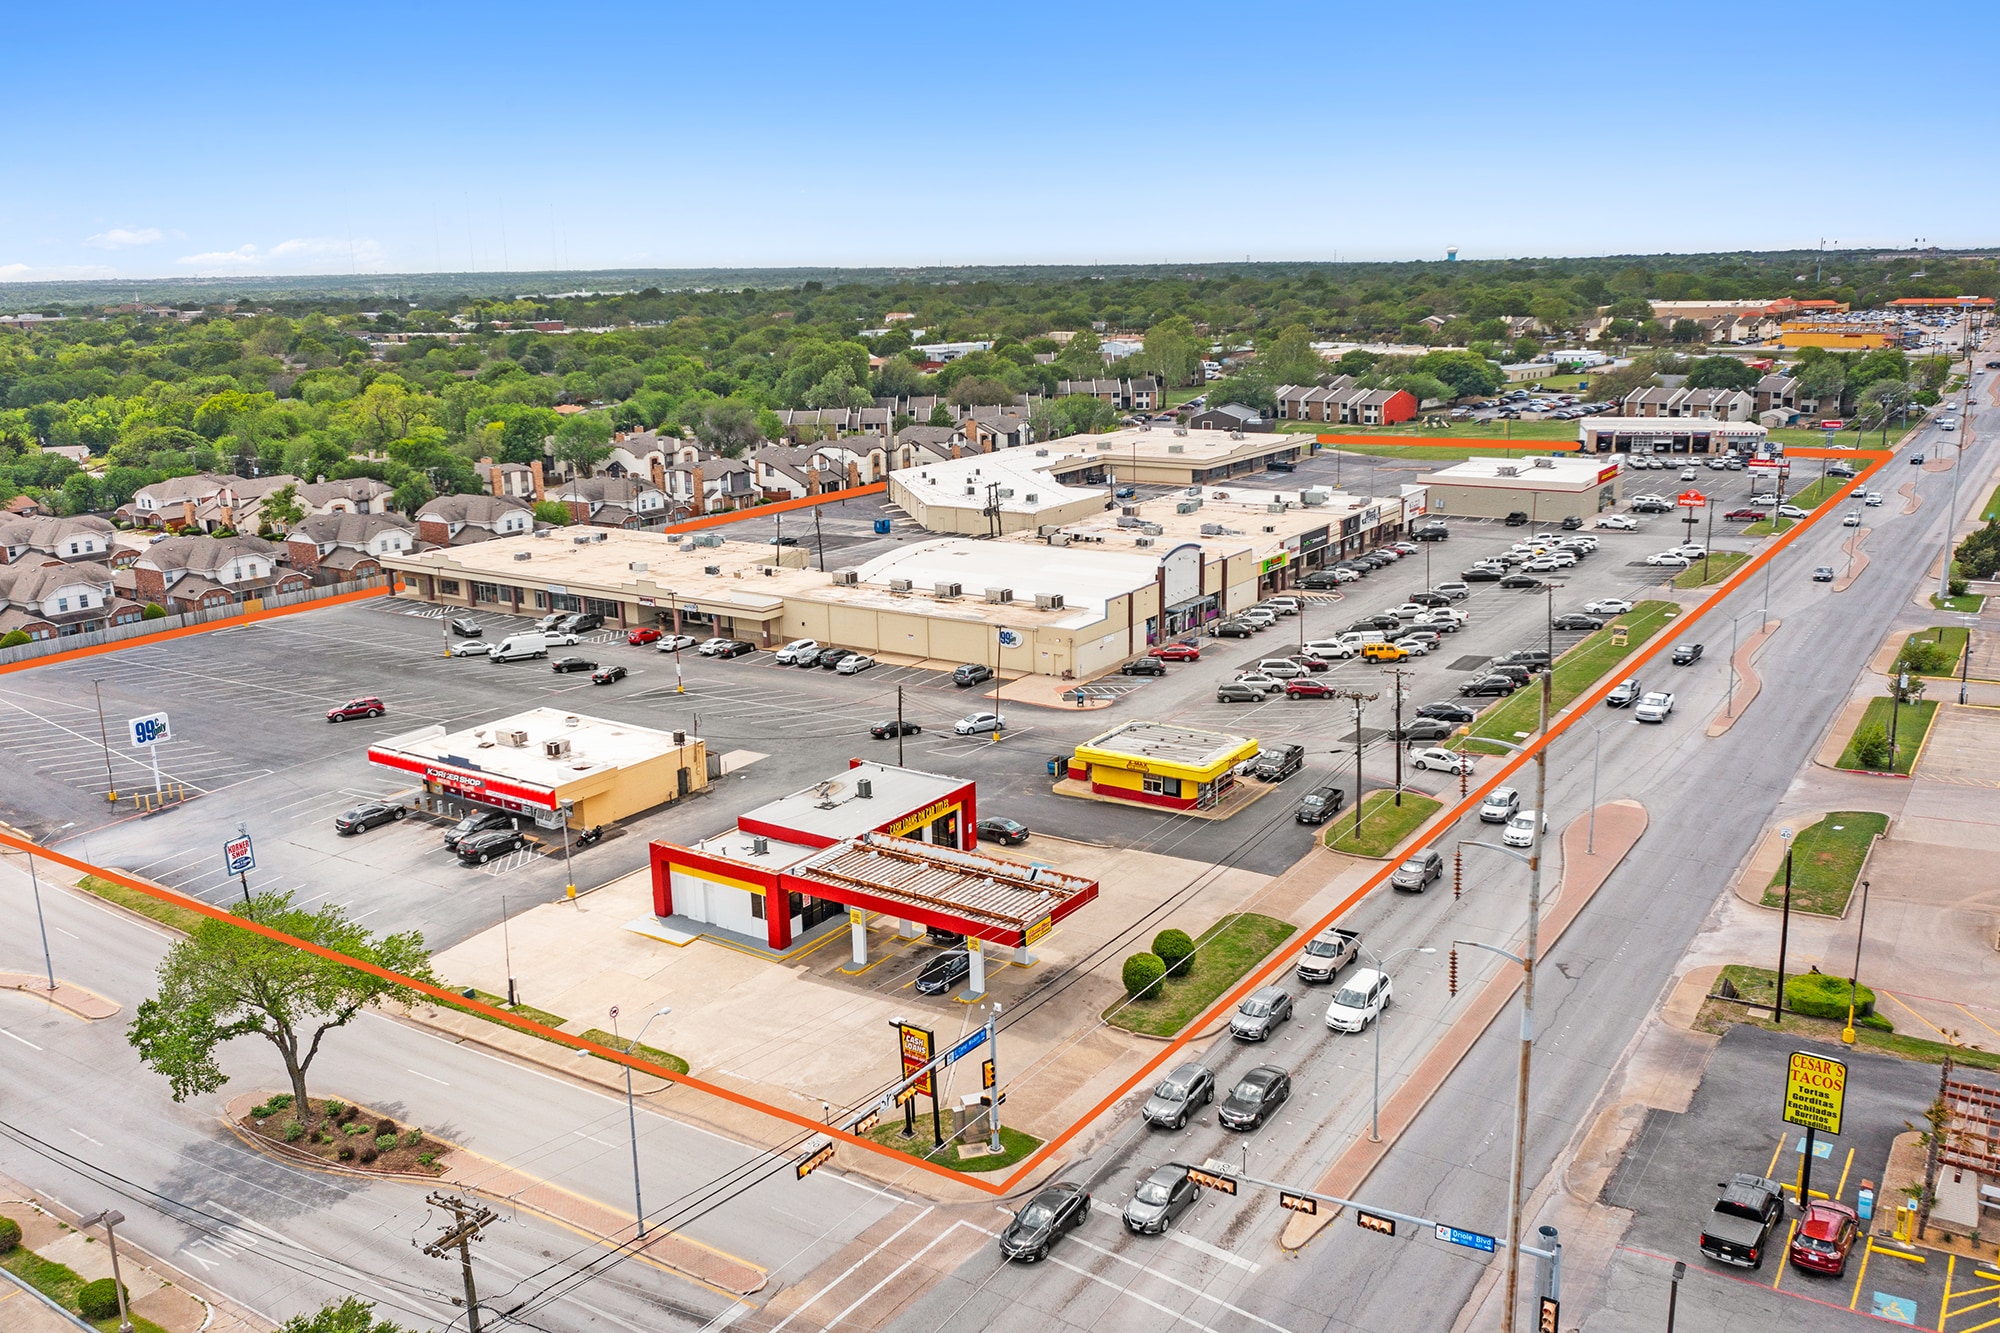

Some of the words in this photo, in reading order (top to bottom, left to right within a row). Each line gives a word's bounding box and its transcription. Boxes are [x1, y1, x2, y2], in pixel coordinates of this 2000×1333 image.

[460, 776, 482, 787] SHOP
[889, 821, 902, 835] CASH
[902, 814, 918, 830] LOANS
[227, 840, 250, 854] KORNER
[231, 848, 249, 860] SHOP
[905, 1034, 924, 1046] CASH
[904, 1042, 926, 1054] LOANS
[1791, 1069, 1843, 1091] TACOS
[1798, 1085, 1830, 1099] Tortas
[1792, 1093, 1835, 1109] Gorditas
[1788, 1100, 1838, 1119] Enchiladas
[1795, 1109, 1829, 1124] Burritos
[1789, 1115, 1832, 1132] Quesadillas
[1452, 1229, 1473, 1241] Oriole
[1475, 1235, 1491, 1246] Blvd
